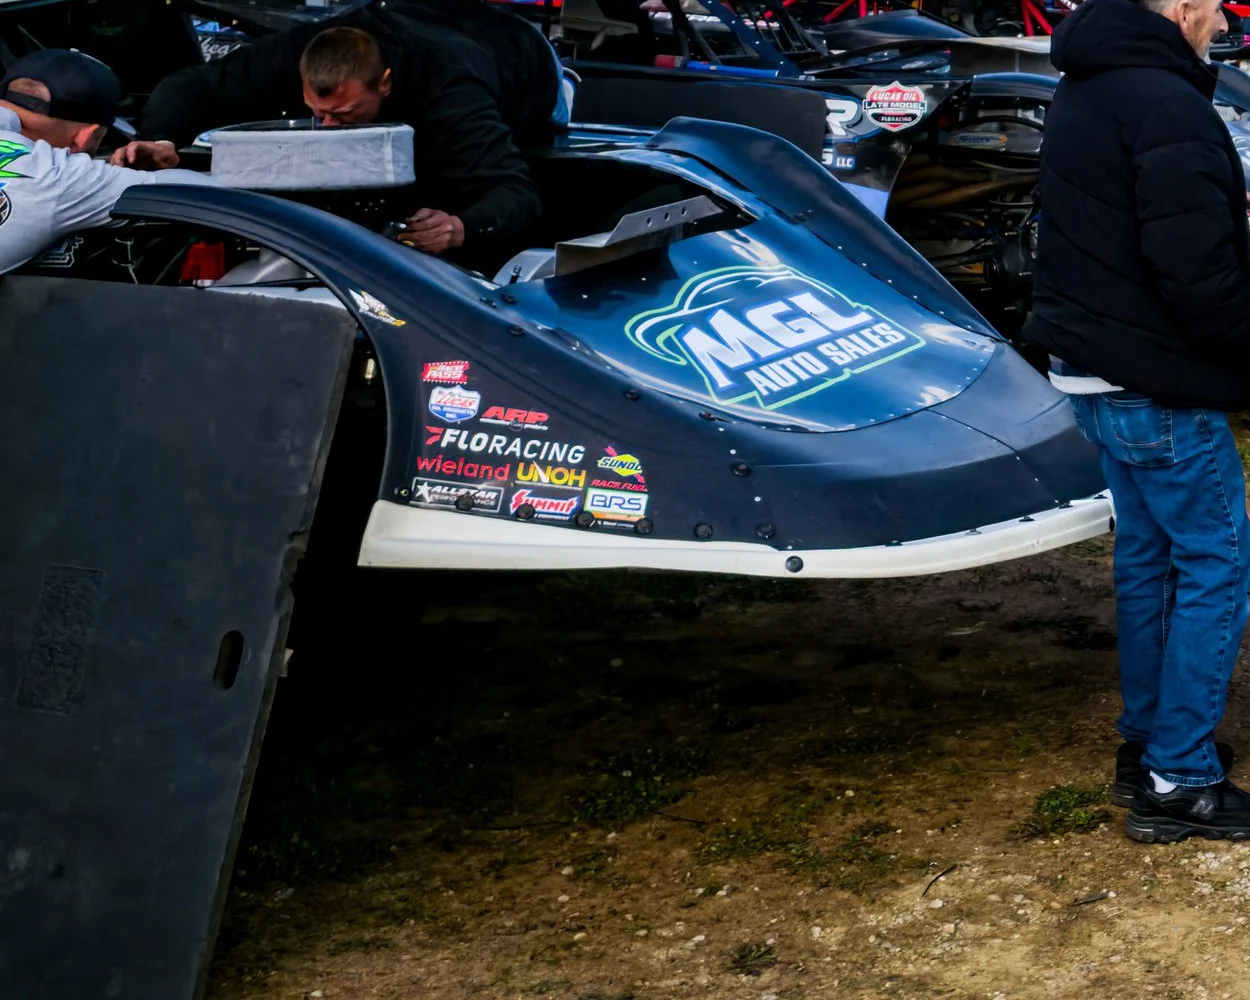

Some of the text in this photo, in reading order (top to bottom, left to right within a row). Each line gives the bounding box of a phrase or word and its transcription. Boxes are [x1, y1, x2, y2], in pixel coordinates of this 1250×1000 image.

[873, 91, 917, 100] LUCAS OIL
[866, 101, 924, 110] LATE MODEL
[681, 292, 874, 389] MGL
[745, 322, 906, 396] AUTO SALES
[481, 405, 549, 424] ARP
[416, 455, 510, 481] wieland
[516, 461, 587, 487] UNOH
[430, 485, 498, 499] ALLSTAR
[591, 479, 620, 489] RACE
[590, 494, 642, 511] BRS
